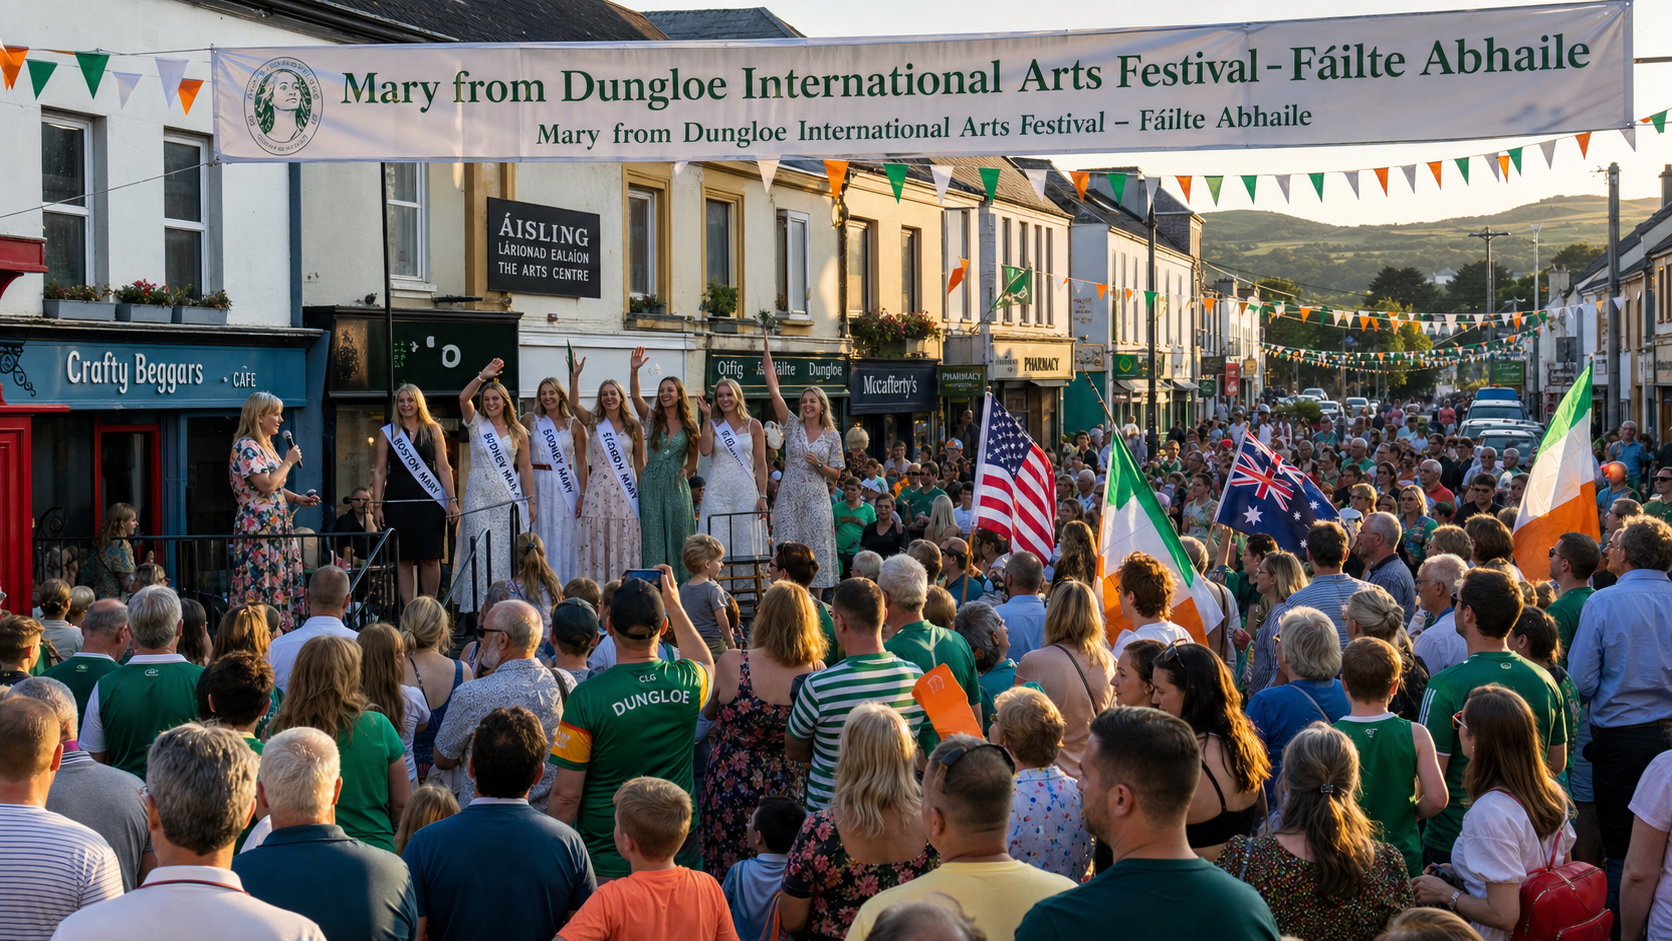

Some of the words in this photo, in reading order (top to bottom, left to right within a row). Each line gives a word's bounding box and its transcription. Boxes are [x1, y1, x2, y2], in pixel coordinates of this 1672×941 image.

[341, 72, 440, 113] Mary
[453, 70, 546, 103] from
[561, 67, 727, 111] Dungloe
[741, 60, 1003, 100] International
[1018, 58, 1102, 92] Arts
[1116, 48, 1259, 88] Festival
[1290, 42, 1406, 82] Fáilte
[1419, 32, 1590, 76] Abhaile
[536, 124, 600, 150] Mary
[613, 122, 672, 144] from
[683, 120, 787, 148] Dungloe
[798, 116, 950, 141] International
[959, 116, 1010, 138] Arts
[1019, 111, 1105, 136] Festival
[1139, 108, 1206, 132] Fáilte
[1215, 103, 1312, 129] Abhaile
[499, 212, 589, 247] ÁISLING
[498, 261, 517, 275] THE
[522, 264, 547, 278] ARTS
[553, 267, 589, 281] CENTRE
[66, 350, 129, 394] Crafty
[134, 352, 204, 394] Beggars
[717, 360, 744, 379] Oifig
[809, 361, 843, 379] Dungloe
[942, 372, 982, 380] PHARMACY
[1024, 357, 1060, 371] PHARMACY
[863, 374, 918, 399] Mccafferty's
[393, 438, 421, 471] BOSTON
[419, 472, 440, 494] MARY
[639, 673, 657, 683] CLG
[611, 689, 690, 717] DUNGLOE
